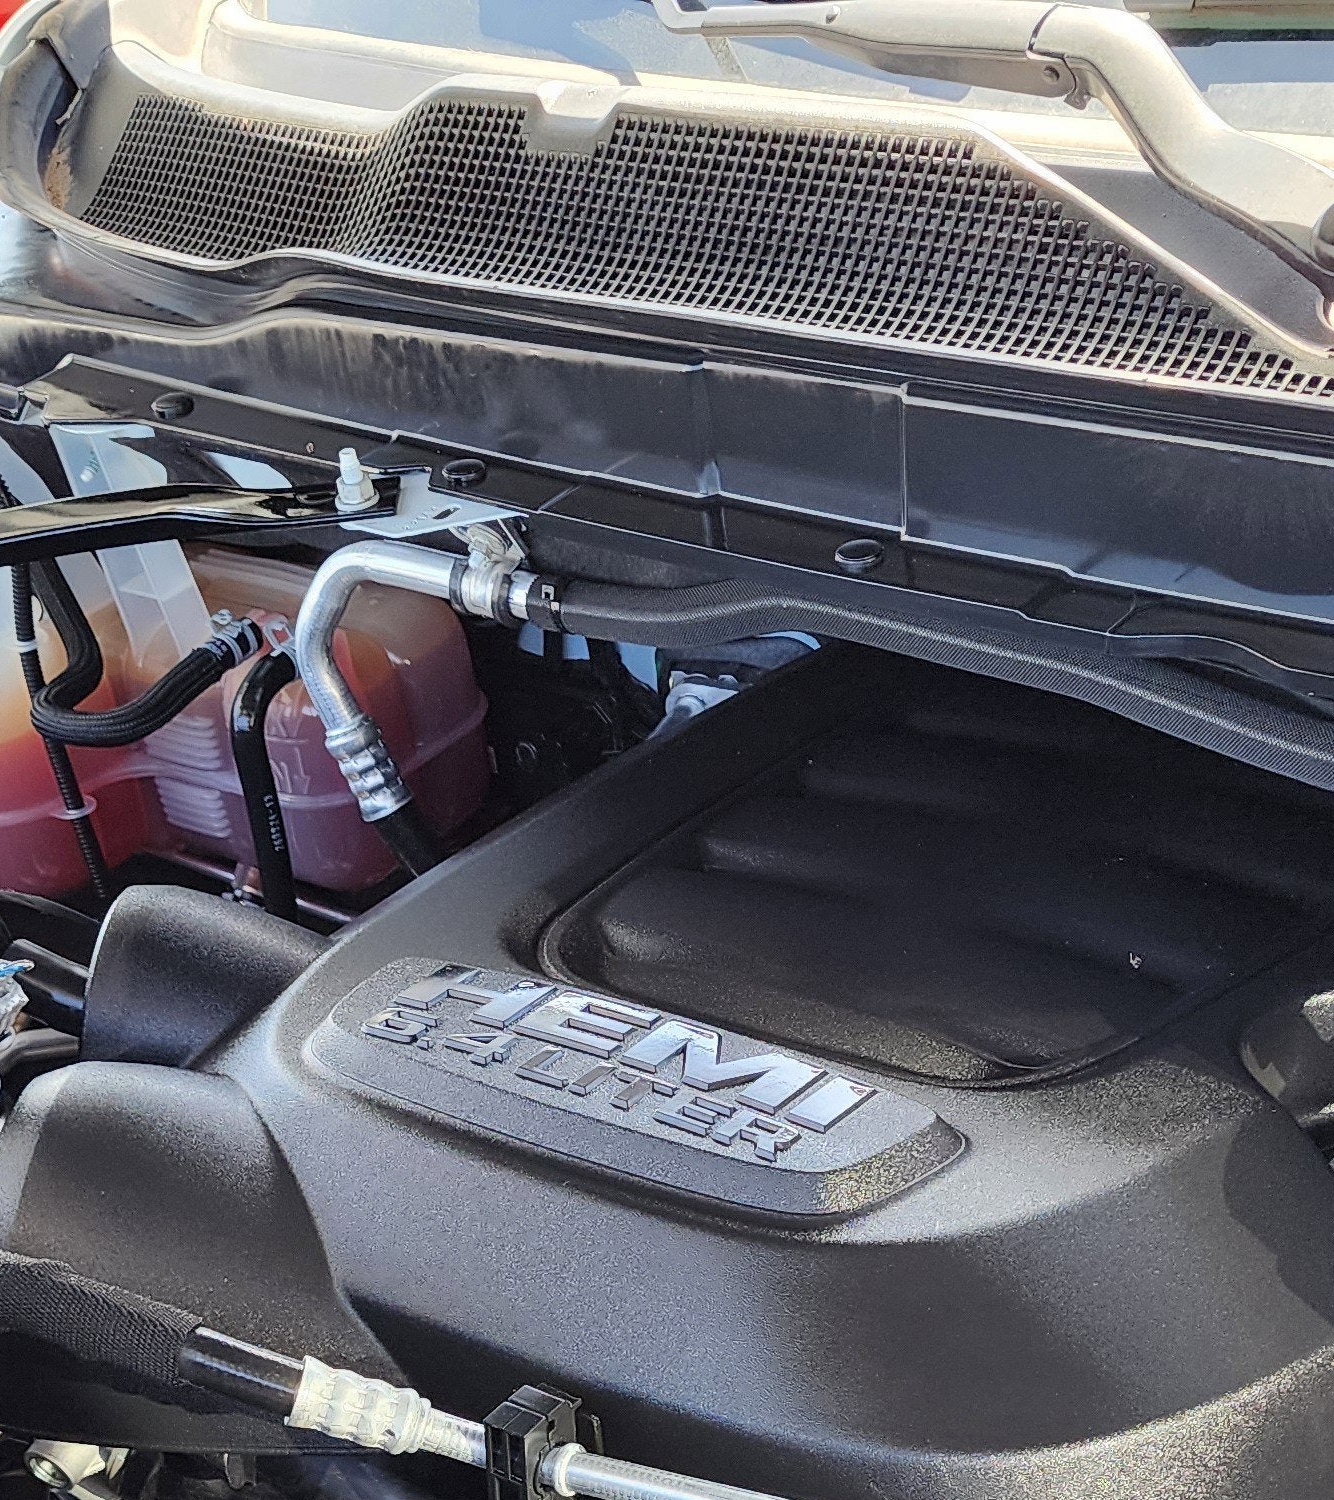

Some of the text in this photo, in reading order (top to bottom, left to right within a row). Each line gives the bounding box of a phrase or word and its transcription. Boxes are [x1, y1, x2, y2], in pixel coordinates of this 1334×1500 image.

[361, 1006, 803, 1162] 6.4 LITER
[394, 962, 877, 1134] HEMI
